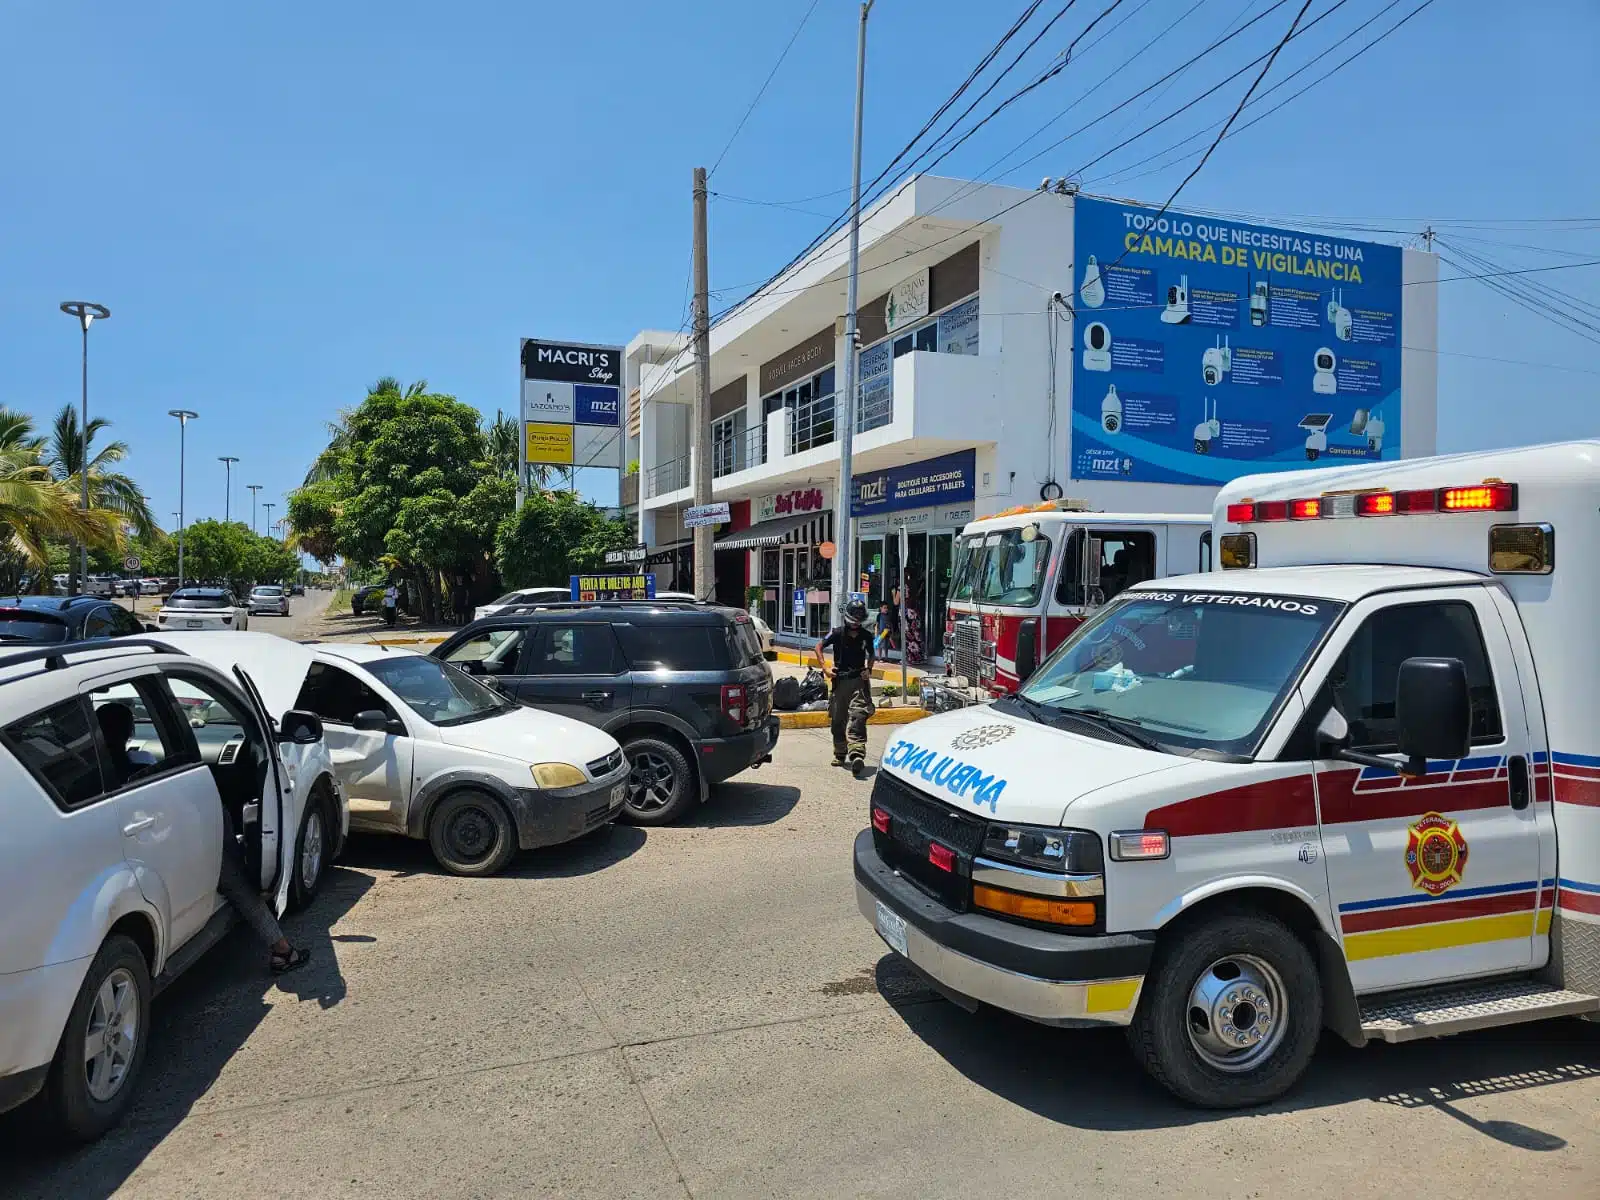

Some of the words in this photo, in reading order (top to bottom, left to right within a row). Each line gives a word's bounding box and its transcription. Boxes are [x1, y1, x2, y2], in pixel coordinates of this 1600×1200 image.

[1123, 212, 1169, 233] TODO
[1173, 220, 1193, 237] LO
[1196, 225, 1228, 242] QUE
[1231, 228, 1312, 255] NECESITAS
[1314, 241, 1332, 257] ES
[1334, 245, 1364, 262] UNA
[1124, 232, 1217, 263] CAMARA
[1221, 246, 1248, 268] DE
[1252, 250, 1363, 284] VIGILANCIA
[538, 349, 609, 367] MACRI'S
[588, 367, 613, 382] Shop
[871, 363, 888, 377] VENTA
[590, 400, 617, 411] mzt
[1092, 457, 1119, 470] mzt
[861, 476, 882, 499] mzt
[897, 477, 921, 490] BOUTIQUE
[921, 476, 929, 484] DE
[929, 470, 962, 483] ACCESORIOS
[894, 490, 907, 499] PARA
[908, 485, 936, 497] CELULARES
[937, 483, 942, 492] Y
[942, 480, 966, 491] TABLETS
[579, 577, 598, 590] VENTA
[599, 577, 606, 590] DE
[1116, 592, 1177, 601] OMBEROS
[1181, 594, 1320, 616] VETERANOS
[1298, 849, 1309, 863] 40
